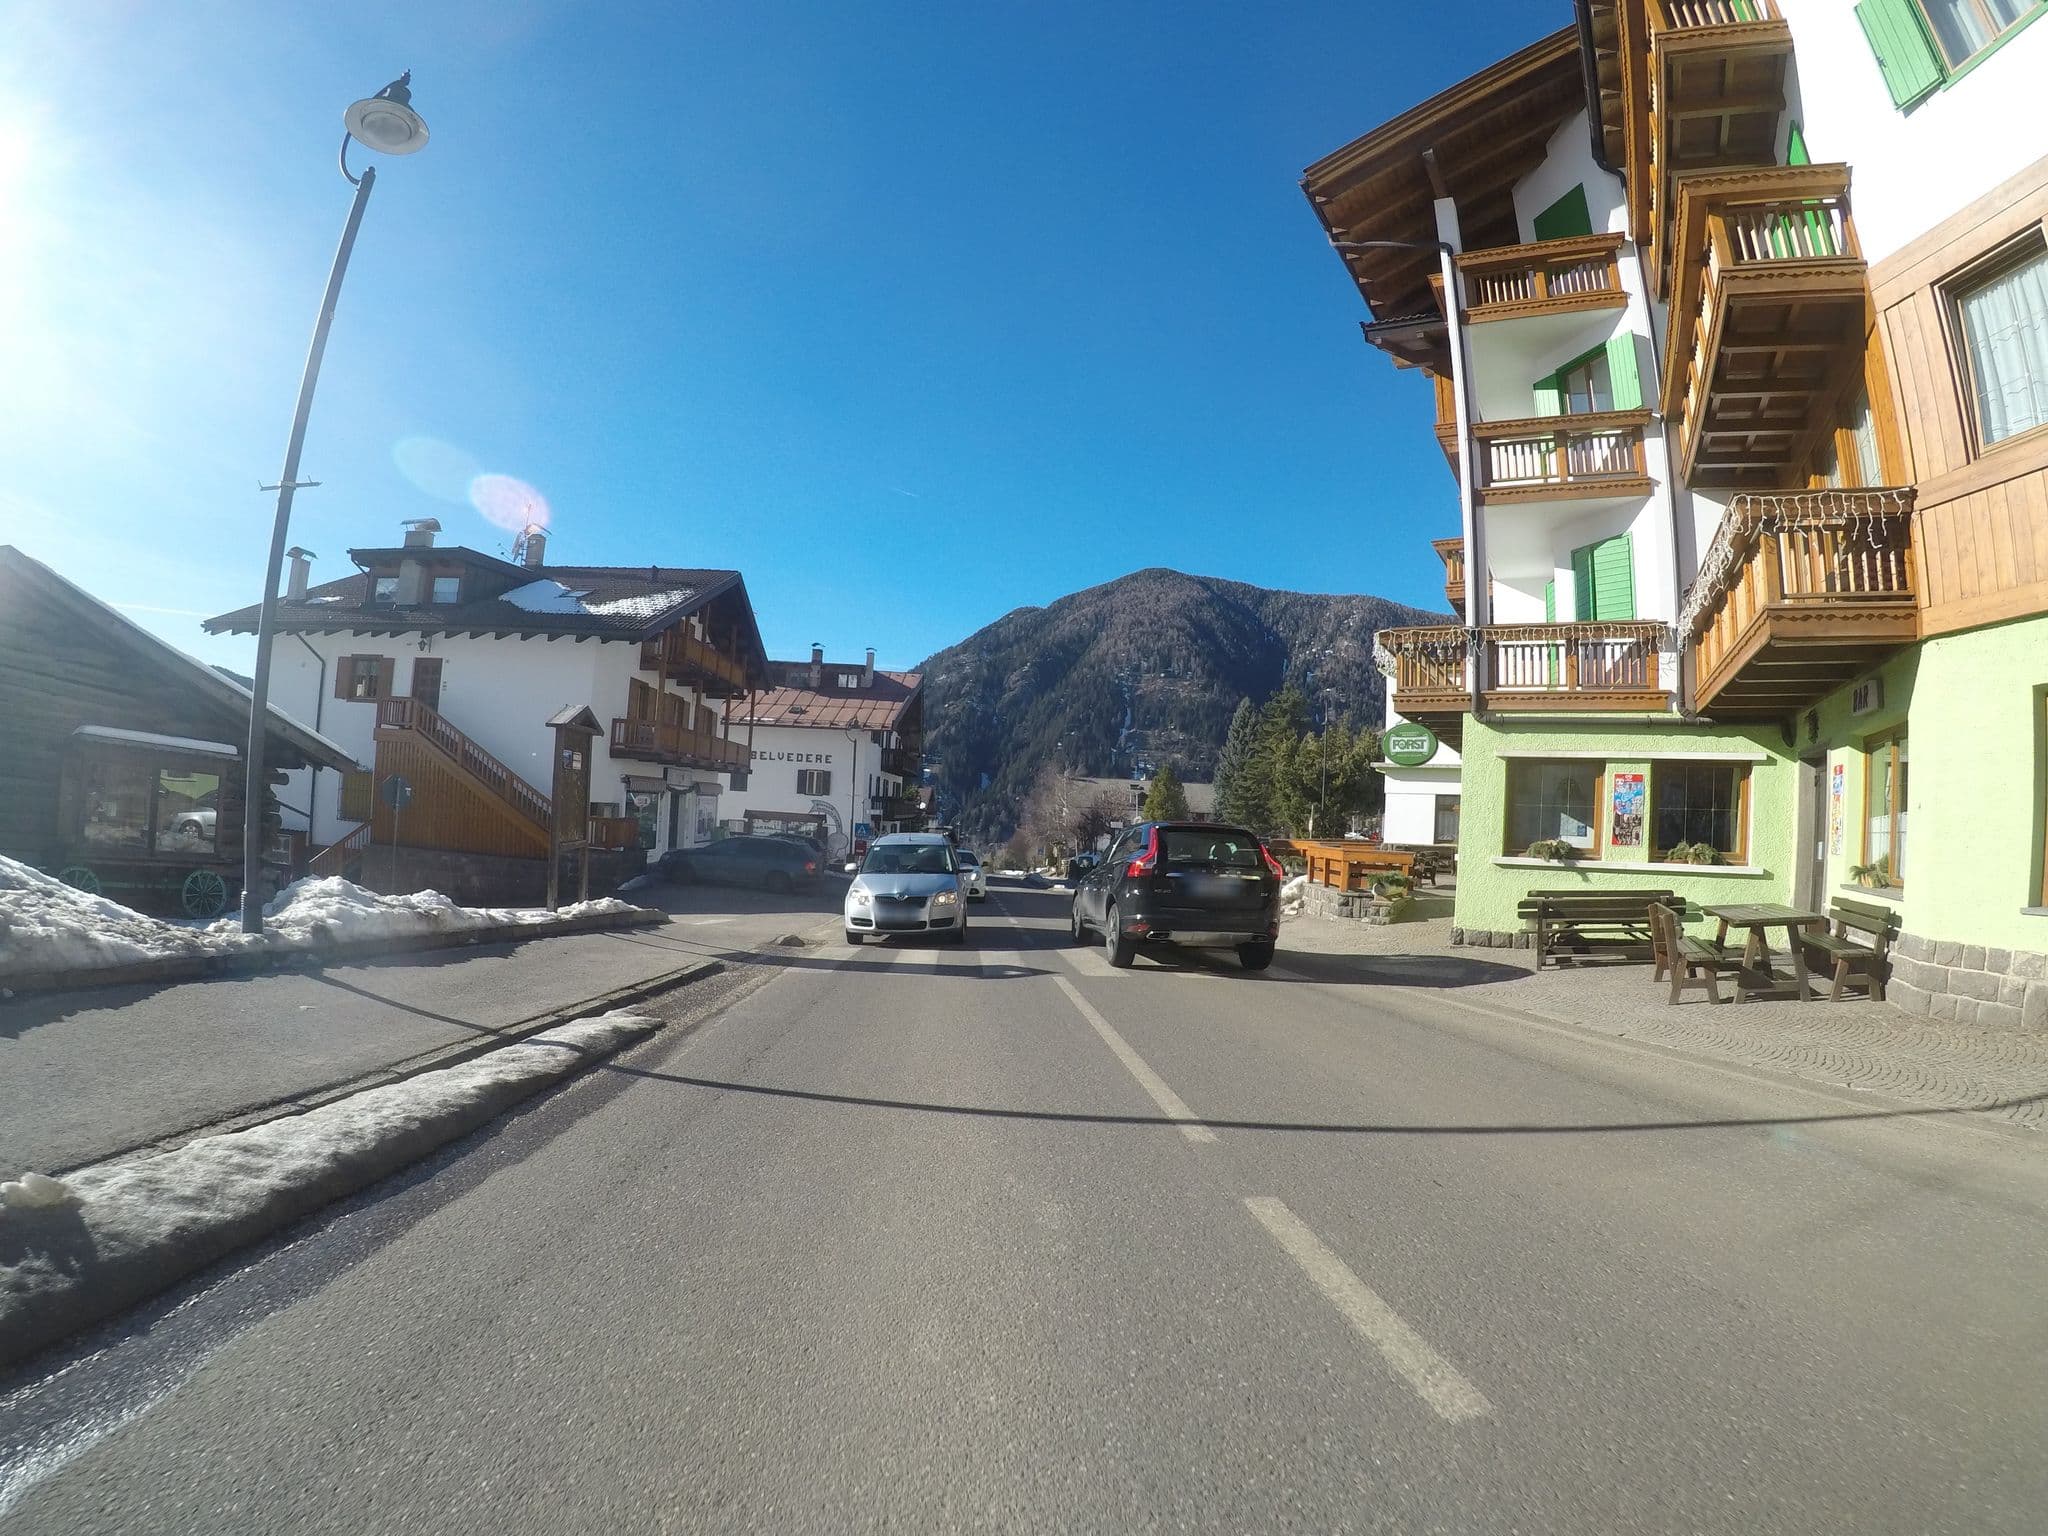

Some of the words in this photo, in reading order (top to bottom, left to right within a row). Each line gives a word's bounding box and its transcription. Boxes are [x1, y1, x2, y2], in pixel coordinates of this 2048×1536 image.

[1853, 685, 1869, 713] BAR
[1392, 739, 1427, 750] FORST
[750, 750, 833, 764] BELVEDERE
